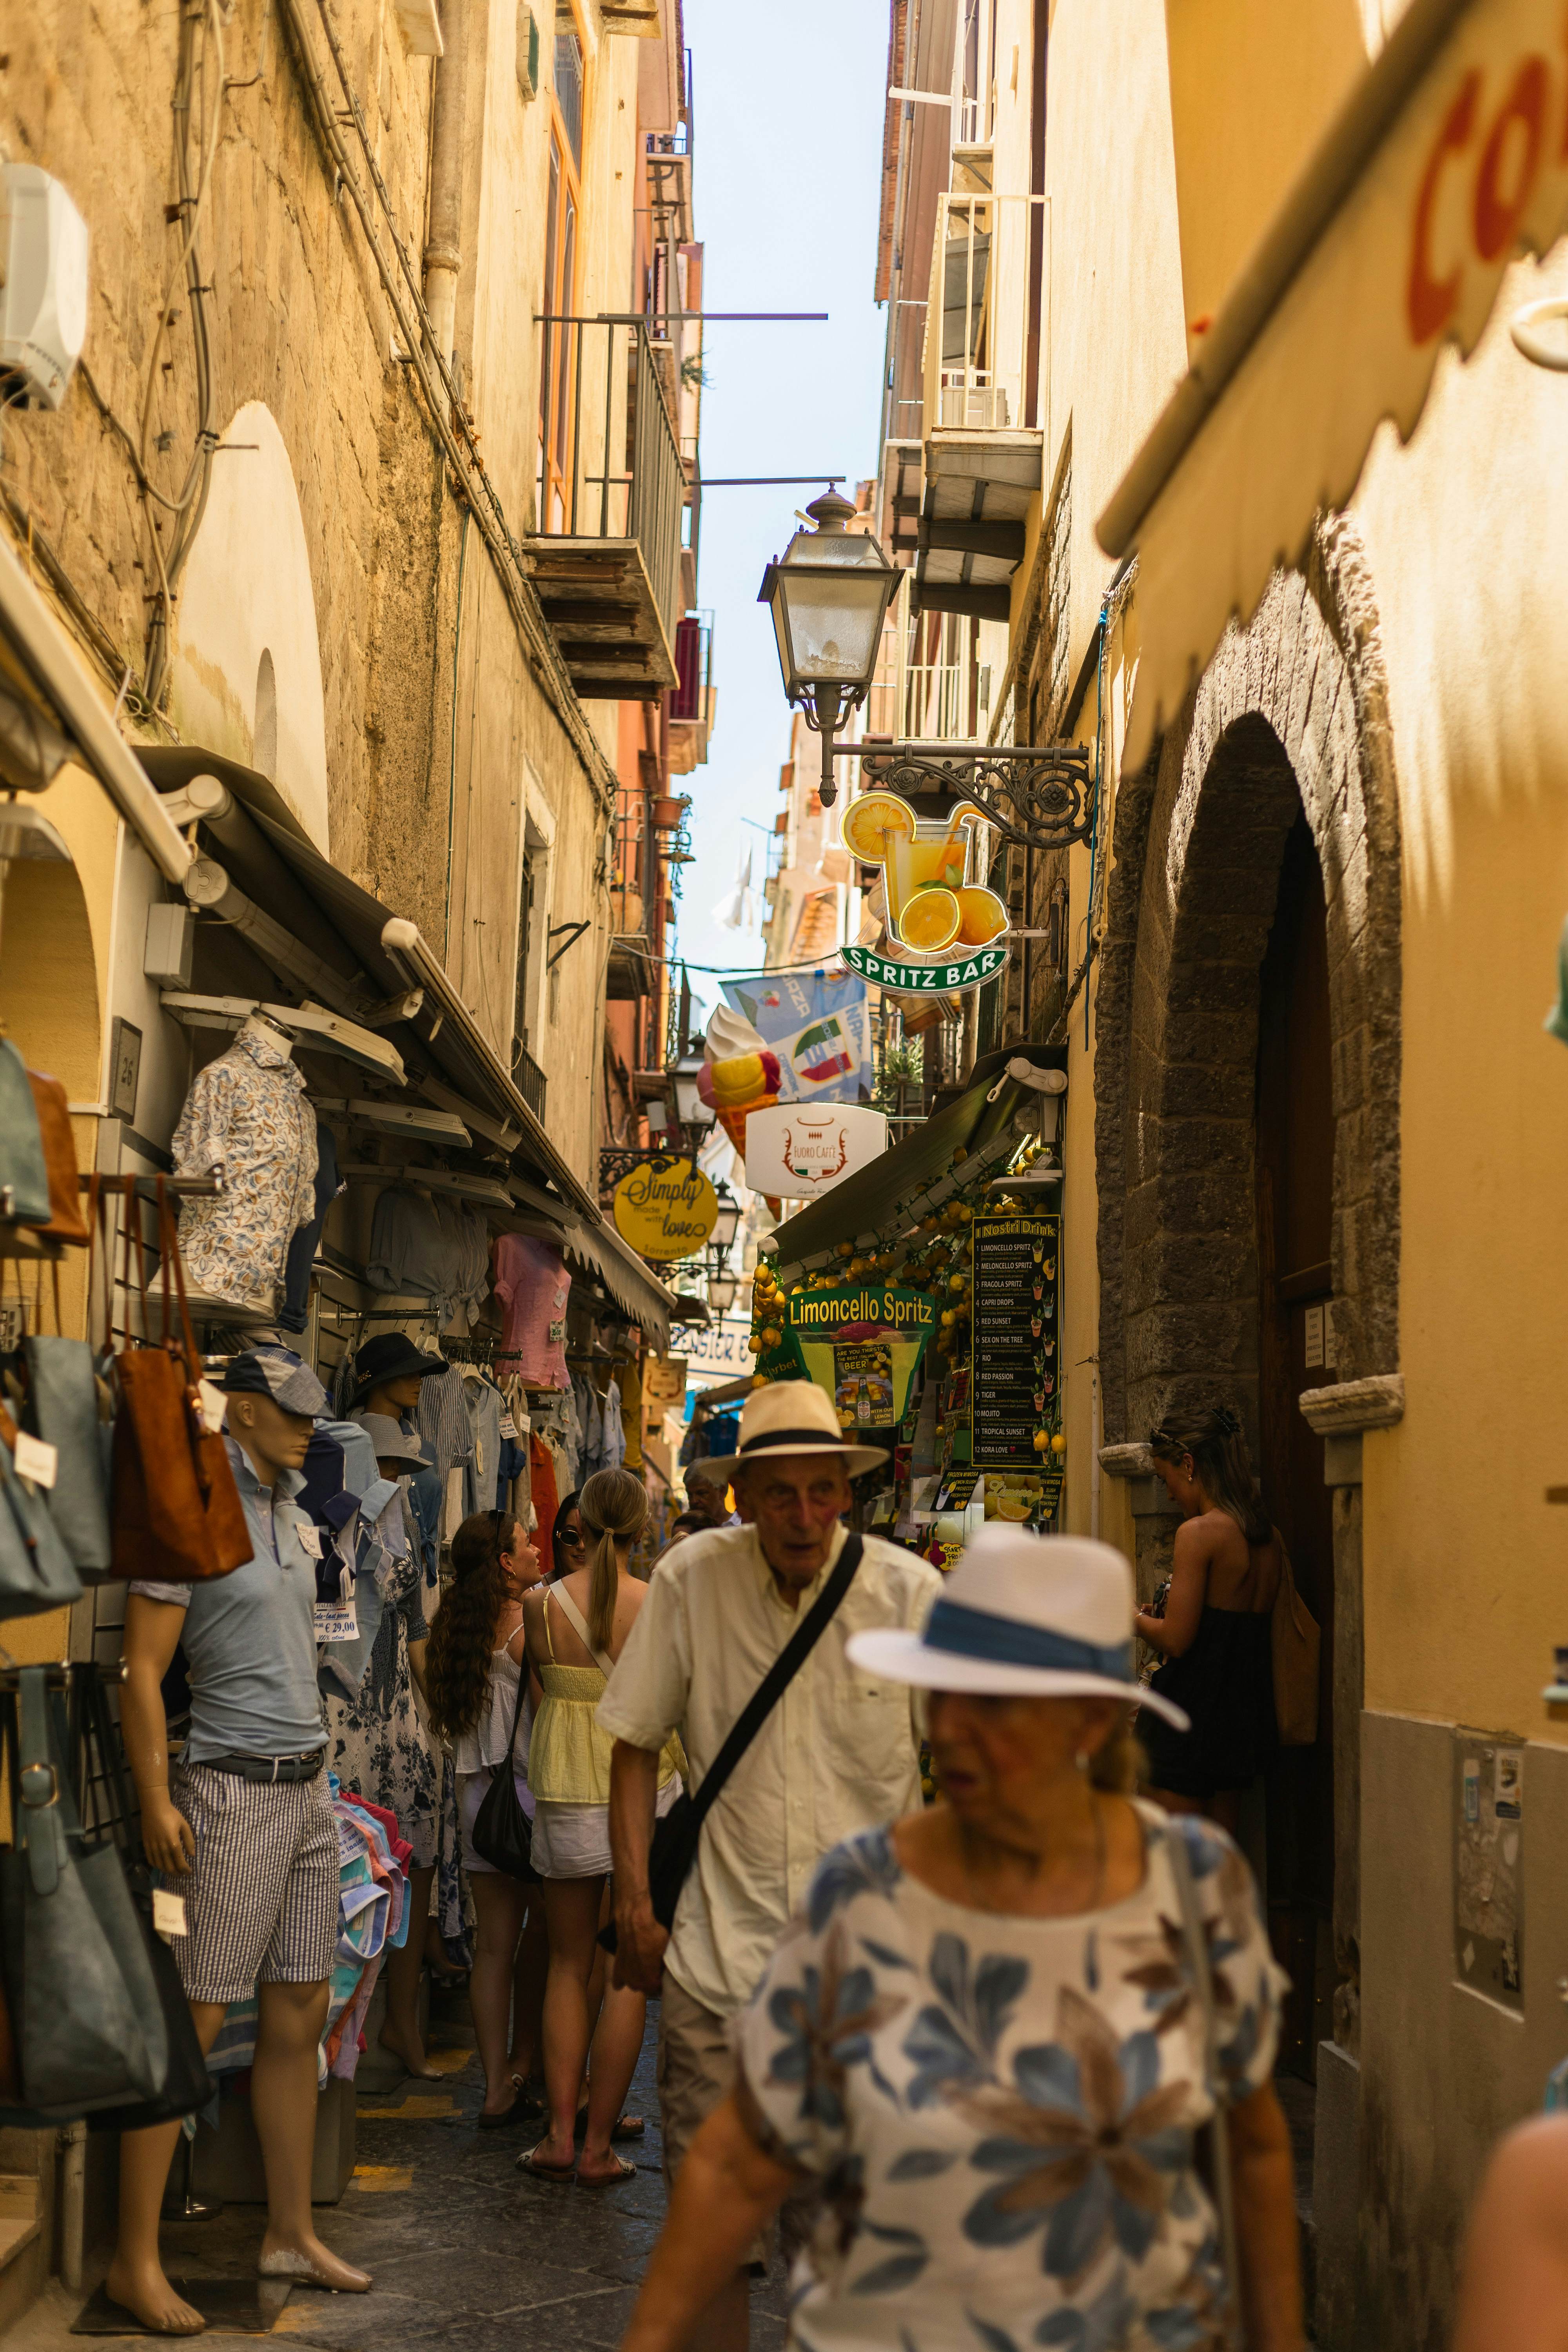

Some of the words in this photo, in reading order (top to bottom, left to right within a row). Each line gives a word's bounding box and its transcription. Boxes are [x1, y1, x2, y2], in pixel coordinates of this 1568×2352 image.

[850, 949, 936, 987] SPRITZ
[947, 952, 995, 985] BAR
[782, 977, 811, 1018] RZA
[121, 1057, 134, 1086] 26
[794, 1145, 815, 1158] FUORO
[621, 1172, 704, 1210] Simply
[662, 1213, 706, 1237] love
[976, 1227, 981, 1238] I
[982, 1220, 1020, 1238] Nostri
[1021, 1220, 1056, 1236] Drink
[790, 1291, 879, 1325] Limoncello
[884, 1292, 933, 1328] Spritz
[844, 1361, 867, 1370] BEER
[325, 1623, 330, 1633] €
[332, 1622, 355, 1634] 29,00
[346, 1837, 364, 1851] inside
[348, 1830, 358, 1841] and
[339, 1855, 352, 1863] ade
